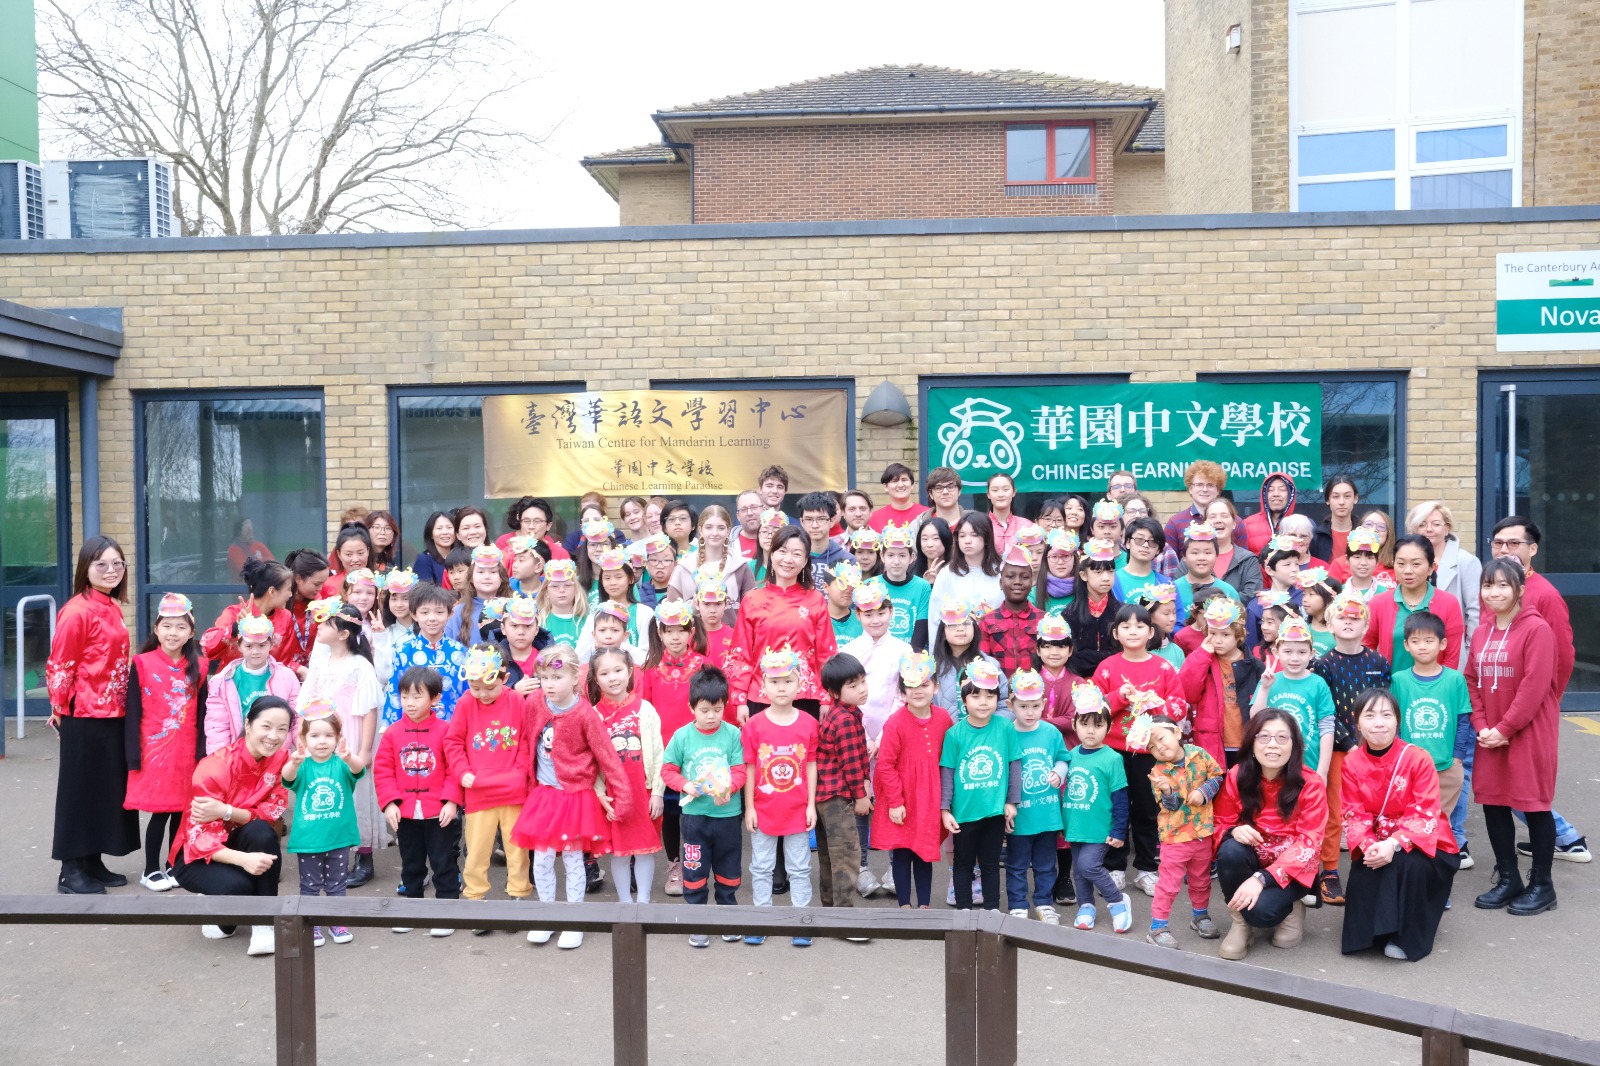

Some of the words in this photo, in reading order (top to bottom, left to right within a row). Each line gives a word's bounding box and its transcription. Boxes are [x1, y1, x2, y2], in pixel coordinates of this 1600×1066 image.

[1504, 264, 1524, 273] The
[1527, 262, 1587, 273] Canterbury
[1030, 400, 1312, 450] 華園中文學校
[556, 438, 595, 449] Taiwan
[598, 437, 636, 449] Centre
[640, 436, 657, 448] for
[660, 436, 715, 448] Mandarin
[719, 436, 771, 449] Learning
[1031, 463, 1115, 480] CHINESE
[1121, 461, 1193, 478] EARN
[1221, 461, 1312, 478] PARADISE
[602, 481, 638, 491] Chinese
[642, 481, 682, 491] Learning
[685, 481, 723, 490] Paradise
[1270, 692, 1307, 705] LEARNING
[1305, 704, 1315, 742] PARADISE
[691, 746, 722, 760] LEARNING
[965, 745, 993, 759] LEARNING
[992, 750, 1004, 780] PARADISE
